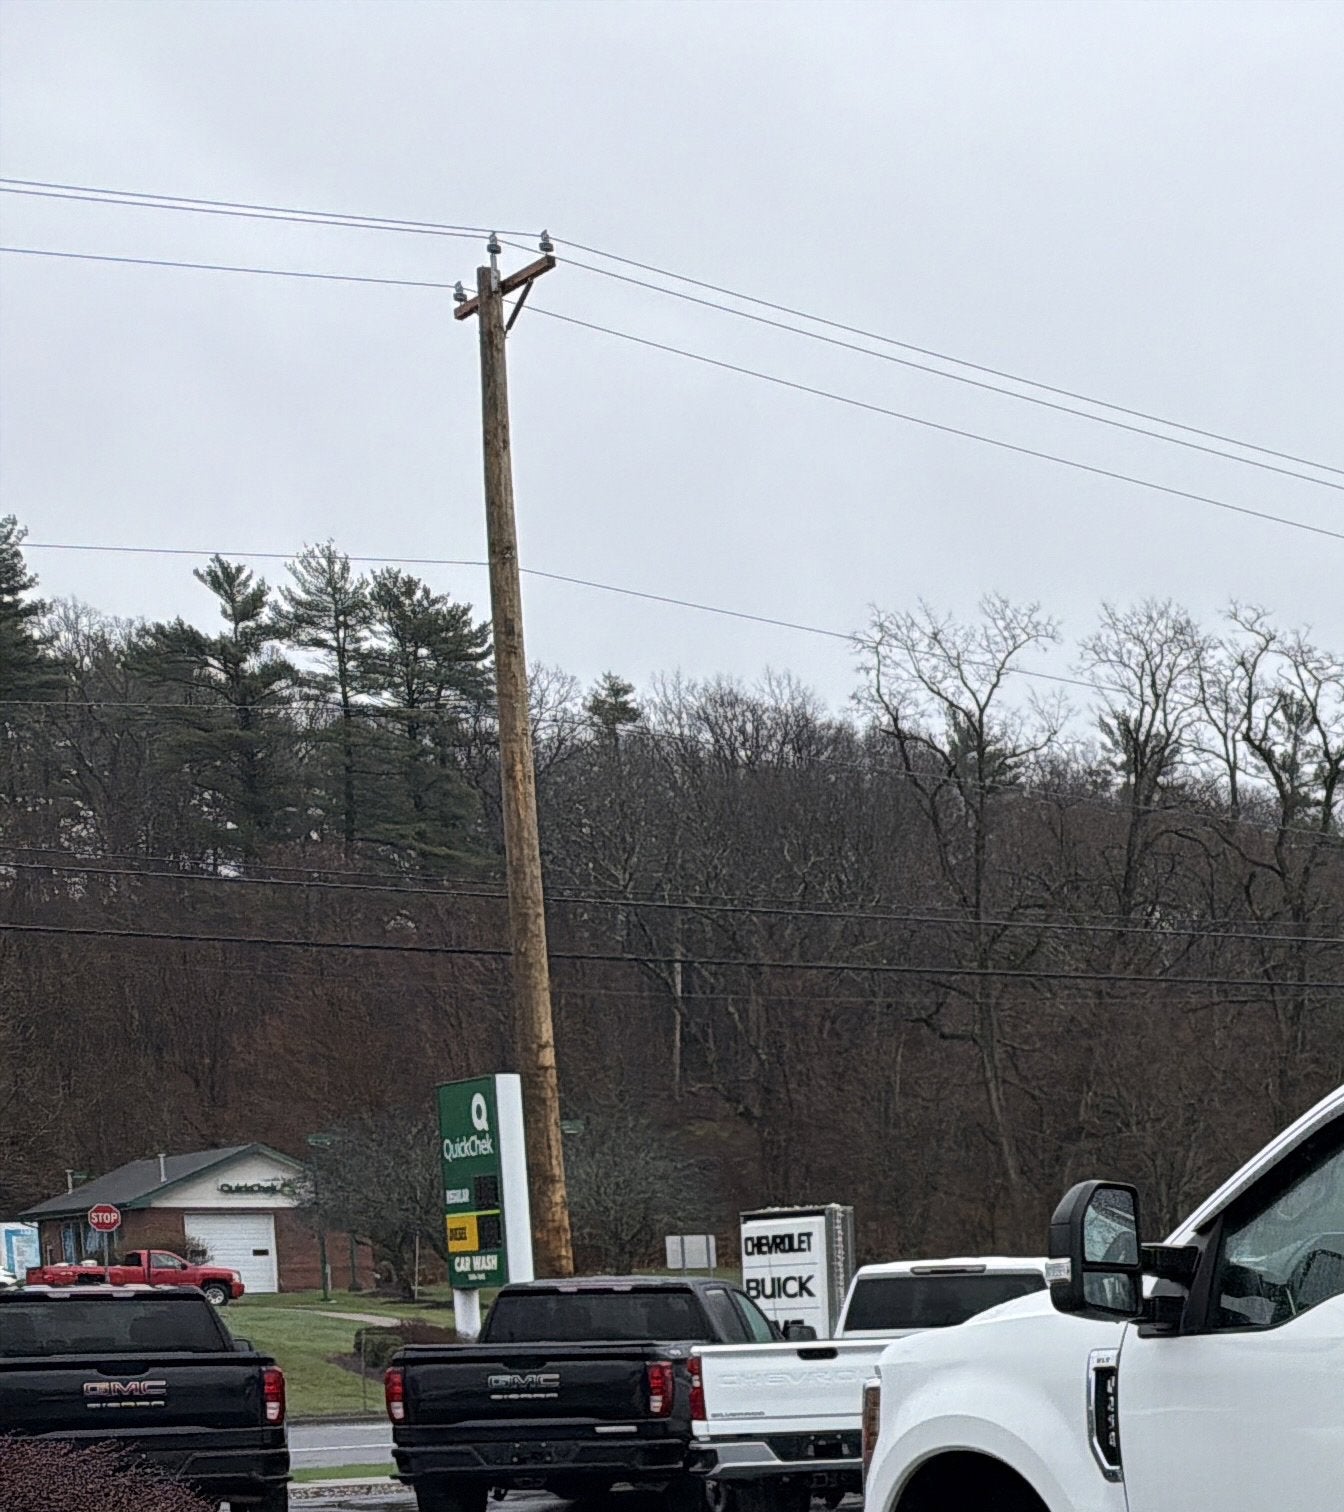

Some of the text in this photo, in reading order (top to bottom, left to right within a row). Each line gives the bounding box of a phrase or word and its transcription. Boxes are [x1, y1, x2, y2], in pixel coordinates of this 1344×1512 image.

[472, 1093, 489, 1131] Q
[444, 1132, 494, 1162] QuickChek
[91, 1212, 118, 1224] STOP
[744, 1231, 813, 1256] CHEVROLET
[454, 1254, 498, 1272] CAR WASH
[745, 1274, 816, 1300] BUICK
[83, 1380, 168, 1397] GMC
[487, 1373, 561, 1388] GMC
